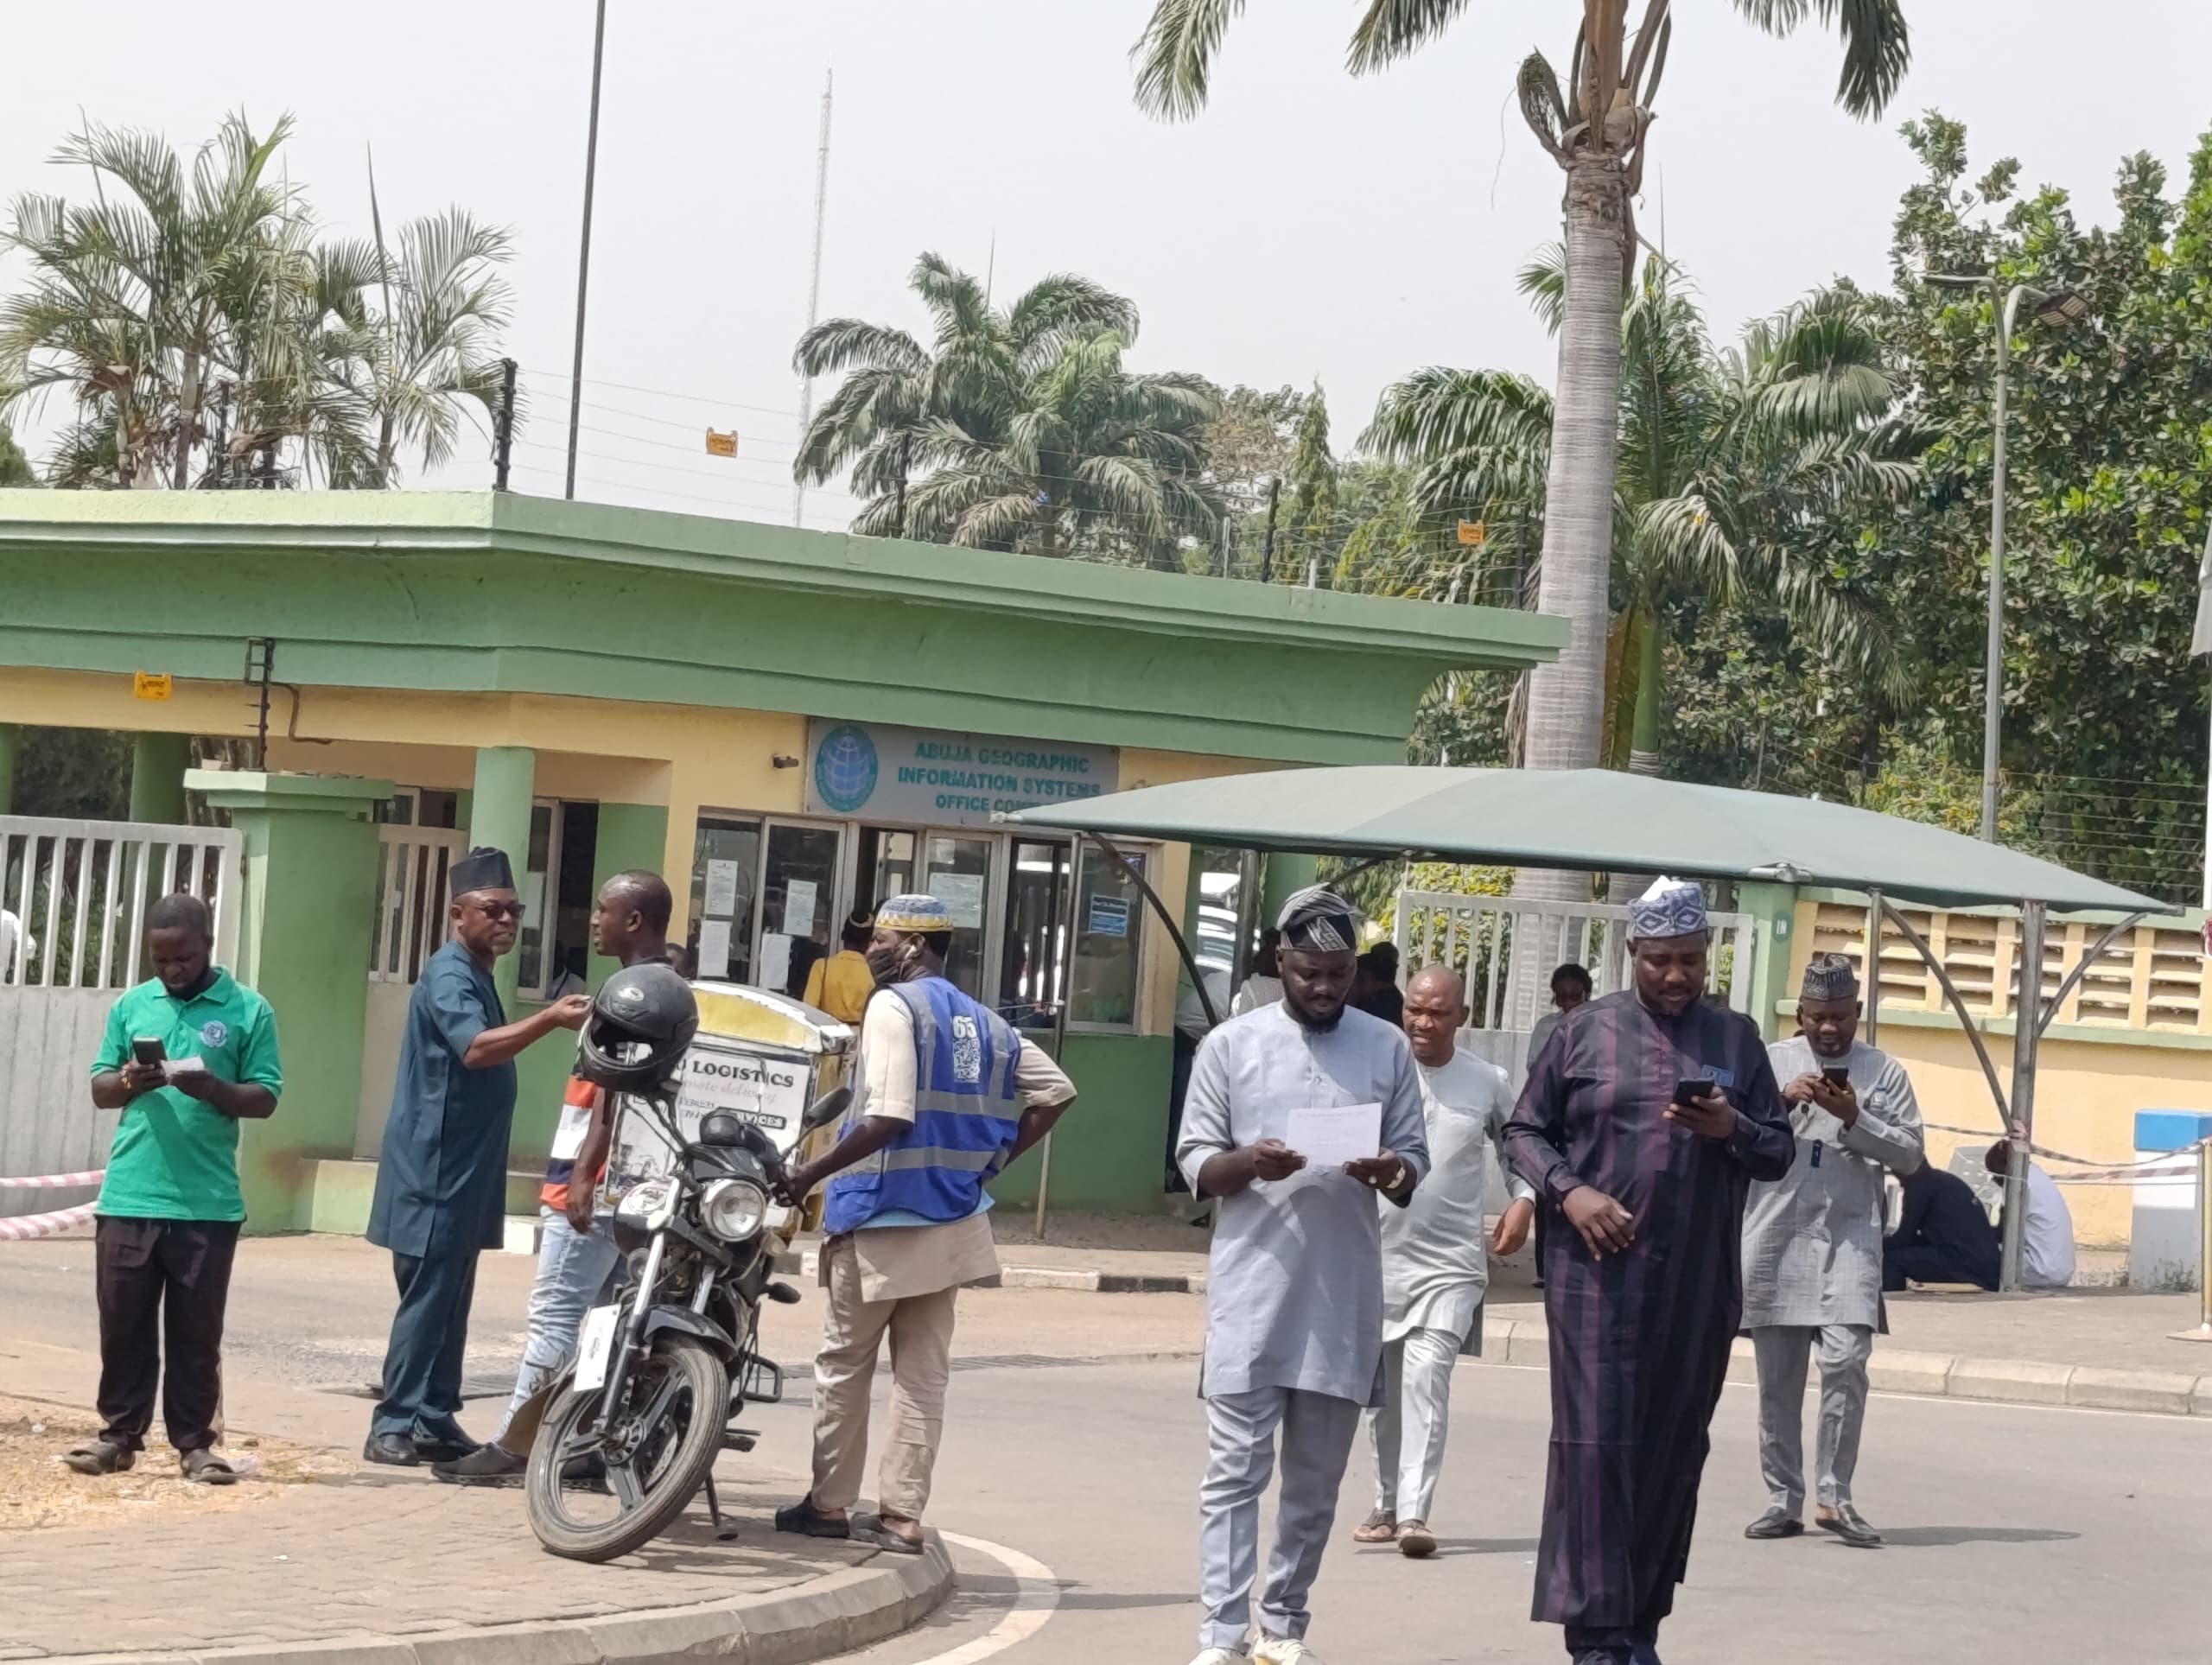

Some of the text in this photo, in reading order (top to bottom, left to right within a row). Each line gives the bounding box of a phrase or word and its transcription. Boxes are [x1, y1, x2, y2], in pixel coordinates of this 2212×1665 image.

[915, 742, 1090, 773] ABUJA GEOGRAPHIC
[898, 766, 1101, 797] INFORMATION SYSTEMS
[936, 794, 989, 811] OFFICE
[952, 1015, 977, 1039] 65
